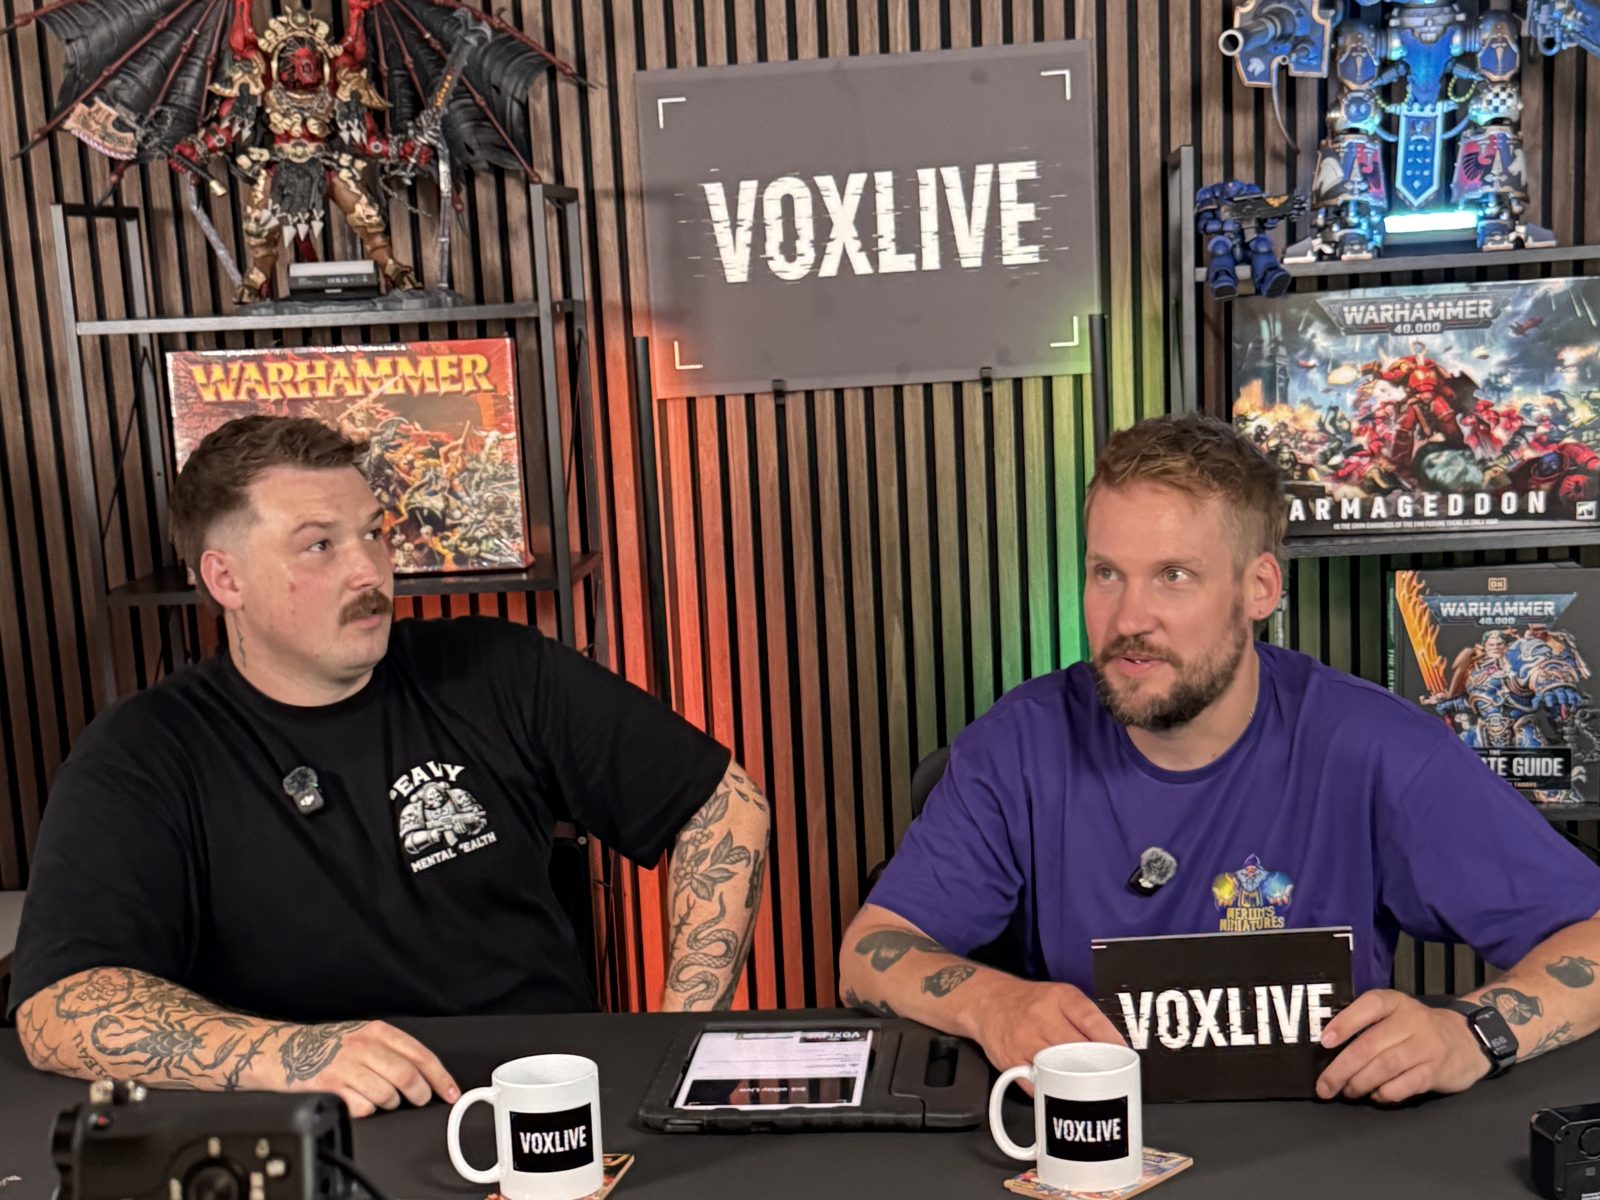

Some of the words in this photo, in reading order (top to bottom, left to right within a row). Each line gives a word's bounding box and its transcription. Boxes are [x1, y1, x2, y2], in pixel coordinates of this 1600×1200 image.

[702, 160, 1041, 283] VOXLIVE
[1343, 299, 1493, 325] WARHAMMER
[190, 353, 497, 402] WARHAMMER
[1289, 491, 1547, 521] ARMAGEDDON
[1489, 579, 1505, 590] DK
[1440, 602, 1555, 616] WARHAMMER
[1512, 757, 1564, 777] GUIDE
[410, 848, 457, 873] MENTAL
[1219, 916, 1285, 931] MINIATURES
[1116, 982, 1333, 1050] VOXLIVE
[519, 1125, 587, 1154] VOXLIVE
[1053, 1117, 1122, 1142] VOXLIVE
